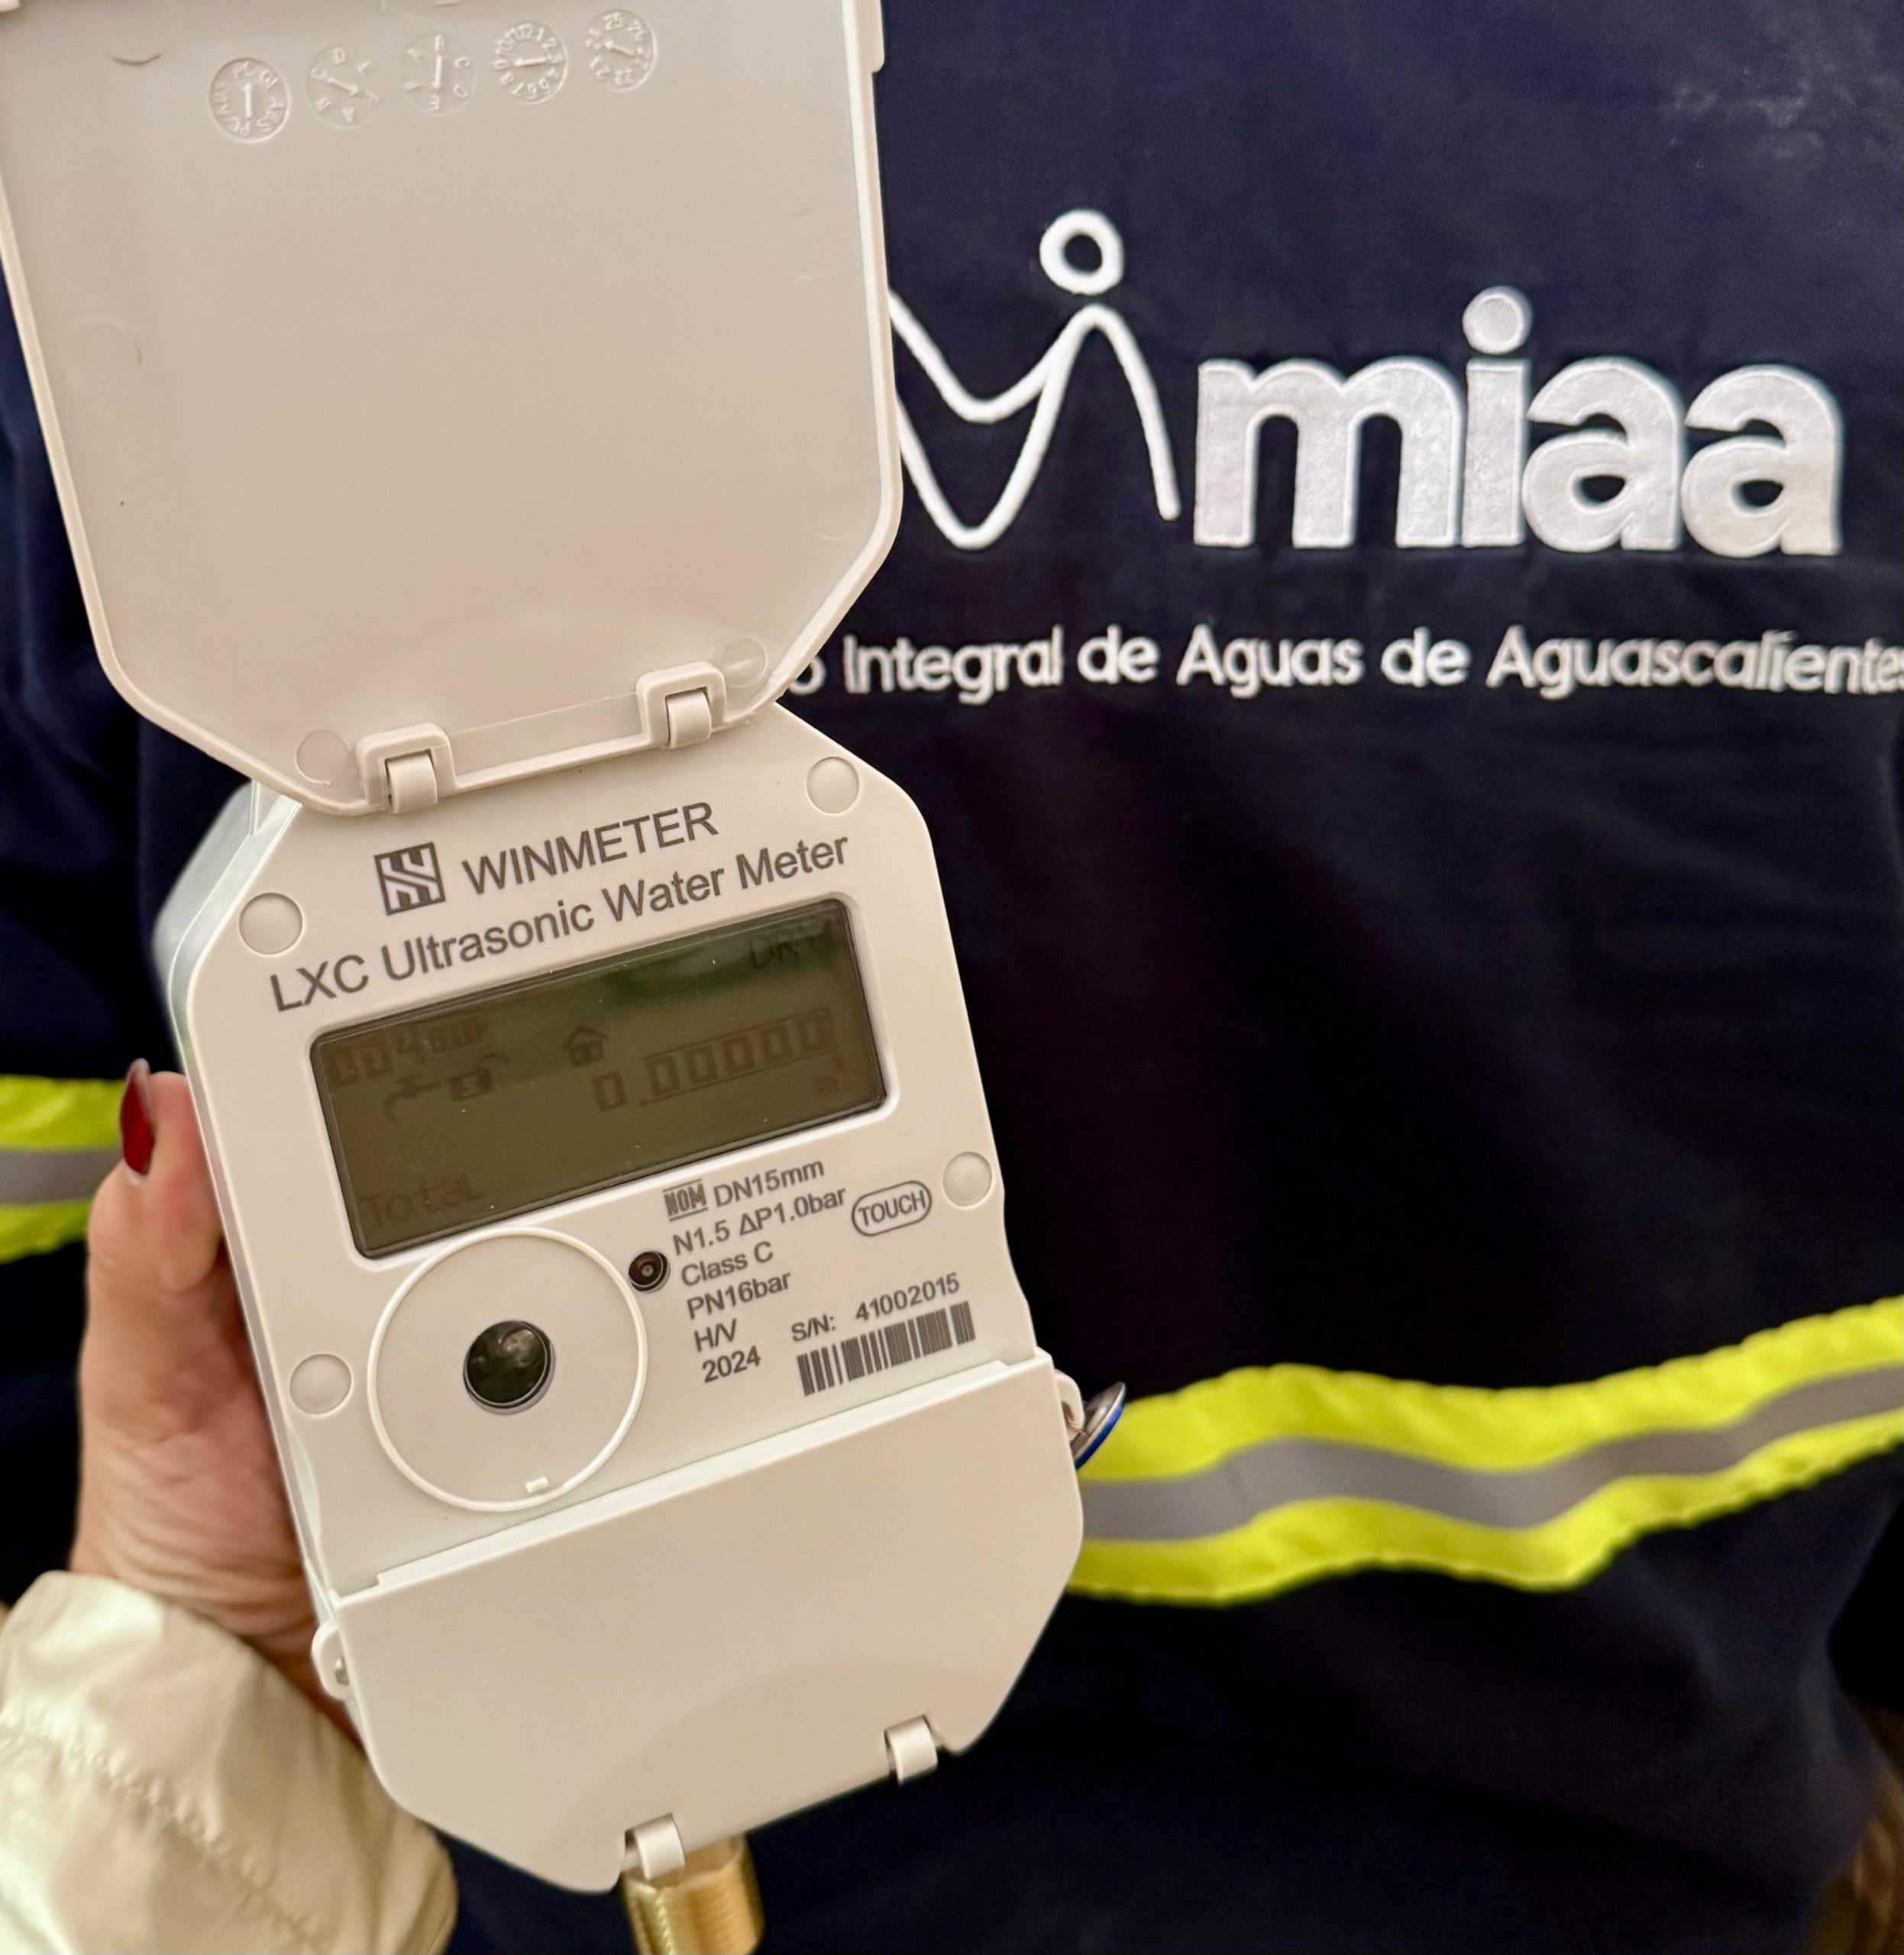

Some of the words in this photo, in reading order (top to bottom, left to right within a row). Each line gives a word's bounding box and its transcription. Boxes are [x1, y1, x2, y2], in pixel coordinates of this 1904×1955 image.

[1193, 286, 1840, 557] miaa
[844, 624, 1064, 705] Integral
[1077, 625, 1159, 684] de
[1176, 624, 1364, 699] Aguas
[1381, 627, 1470, 687] de
[461, 801, 719, 894] WINMETER
[270, 954, 369, 1012] LXC
[381, 900, 595, 982] Ultrasonic
[601, 867, 726, 922] Water
[735, 835, 849, 890] Meter
[713, 1160, 825, 1207] DN15mm
[858, 1190, 926, 1227] TOUCH
[673, 1220, 731, 1256] N1.5
[681, 1253, 748, 1287] Class
[753, 1241, 774, 1264] C
[687, 1272, 792, 1320] PN16bar
[791, 1313, 836, 1343] S/N:
[855, 1272, 961, 1323] 41002015
[693, 1318, 738, 1352] H/V
[702, 1346, 761, 1384] 2024
